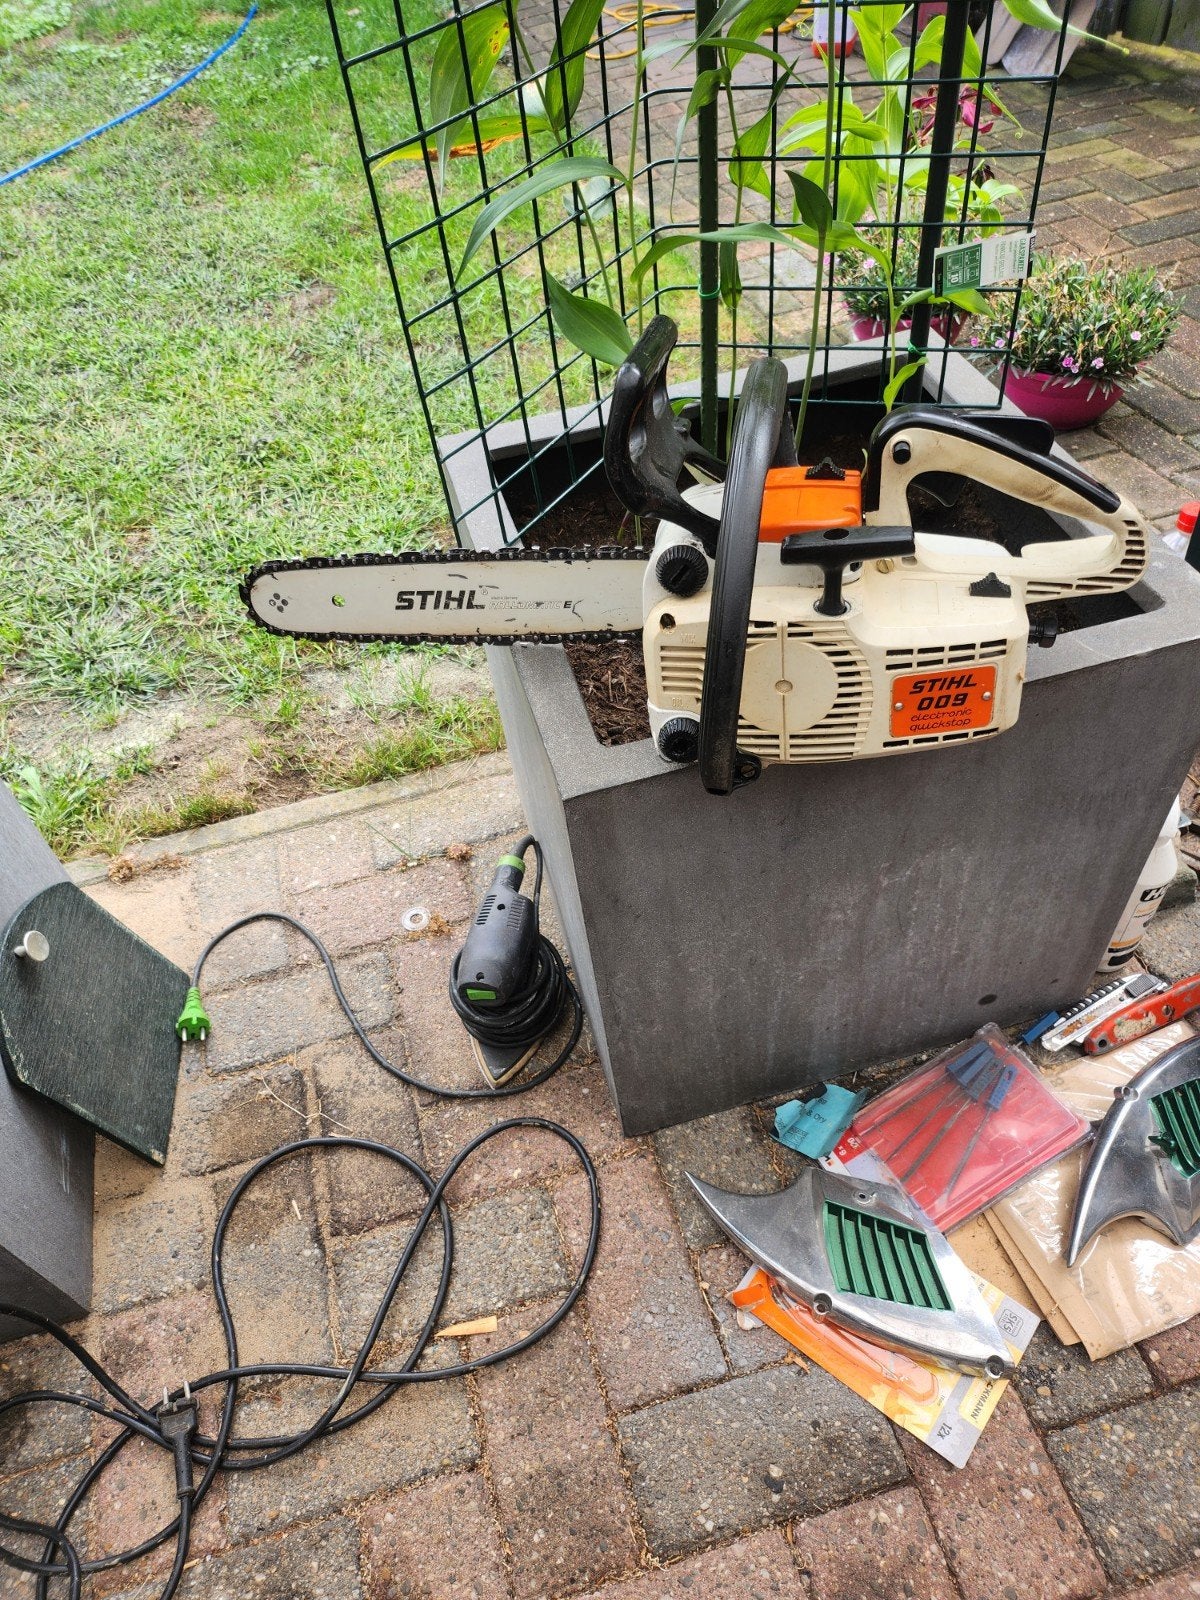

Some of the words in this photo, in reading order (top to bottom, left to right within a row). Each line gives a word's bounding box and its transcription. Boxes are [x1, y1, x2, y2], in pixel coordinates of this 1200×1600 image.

[950, 272, 960, 284] 10
[395, 590, 486, 610] STIHL
[563, 600, 572, 609] E
[909, 674, 978, 695] STIHL
[917, 693, 969, 711] 009
[910, 707, 972, 722] electronic
[909, 718, 971, 733] quickstop
[970, 1380, 994, 1420] CKMANN
